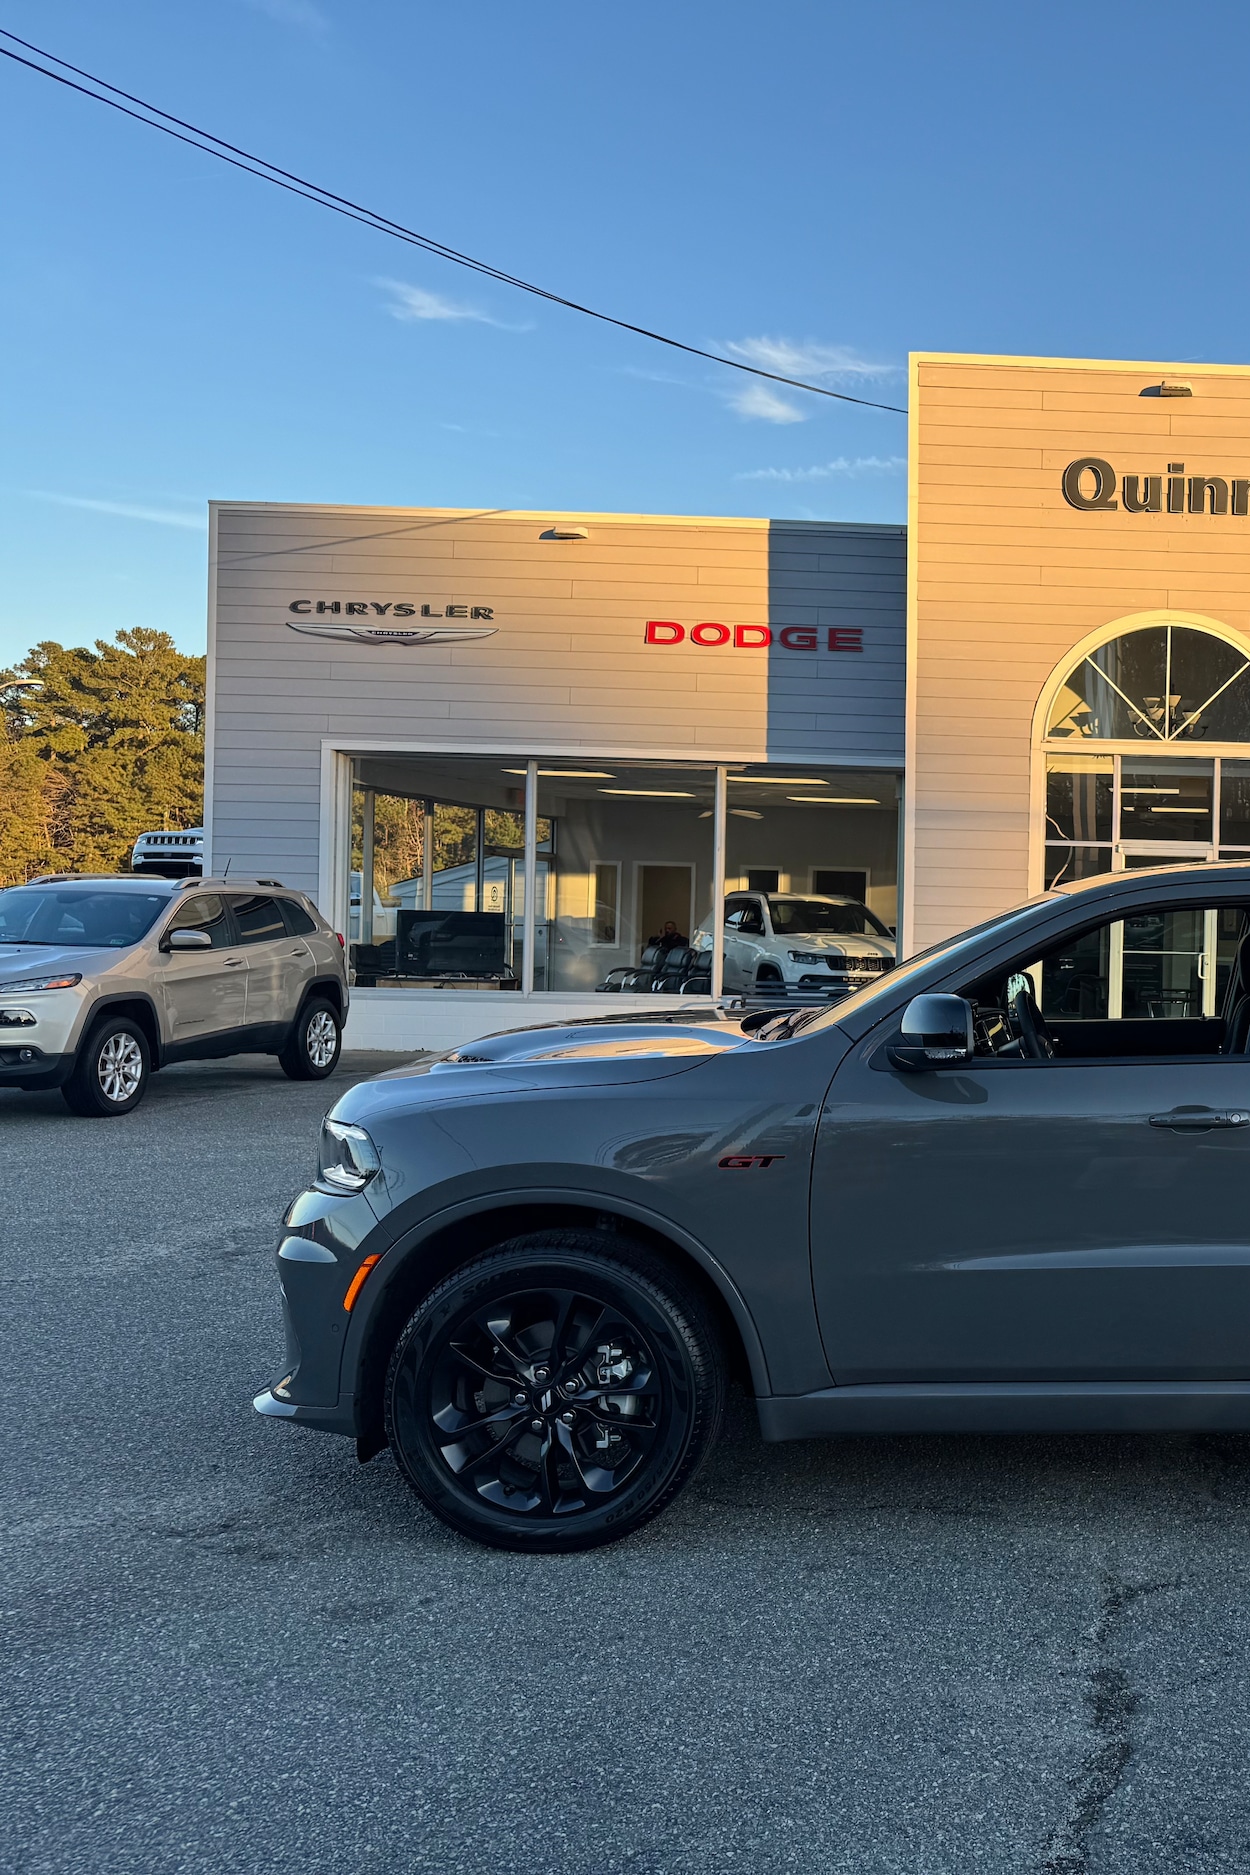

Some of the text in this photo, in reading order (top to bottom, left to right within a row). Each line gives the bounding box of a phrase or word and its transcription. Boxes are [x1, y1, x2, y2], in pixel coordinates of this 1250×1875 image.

[288, 600, 494, 620] CHRYSLER
[644, 621, 863, 652] DODGE
[718, 1155, 786, 1169] GT
